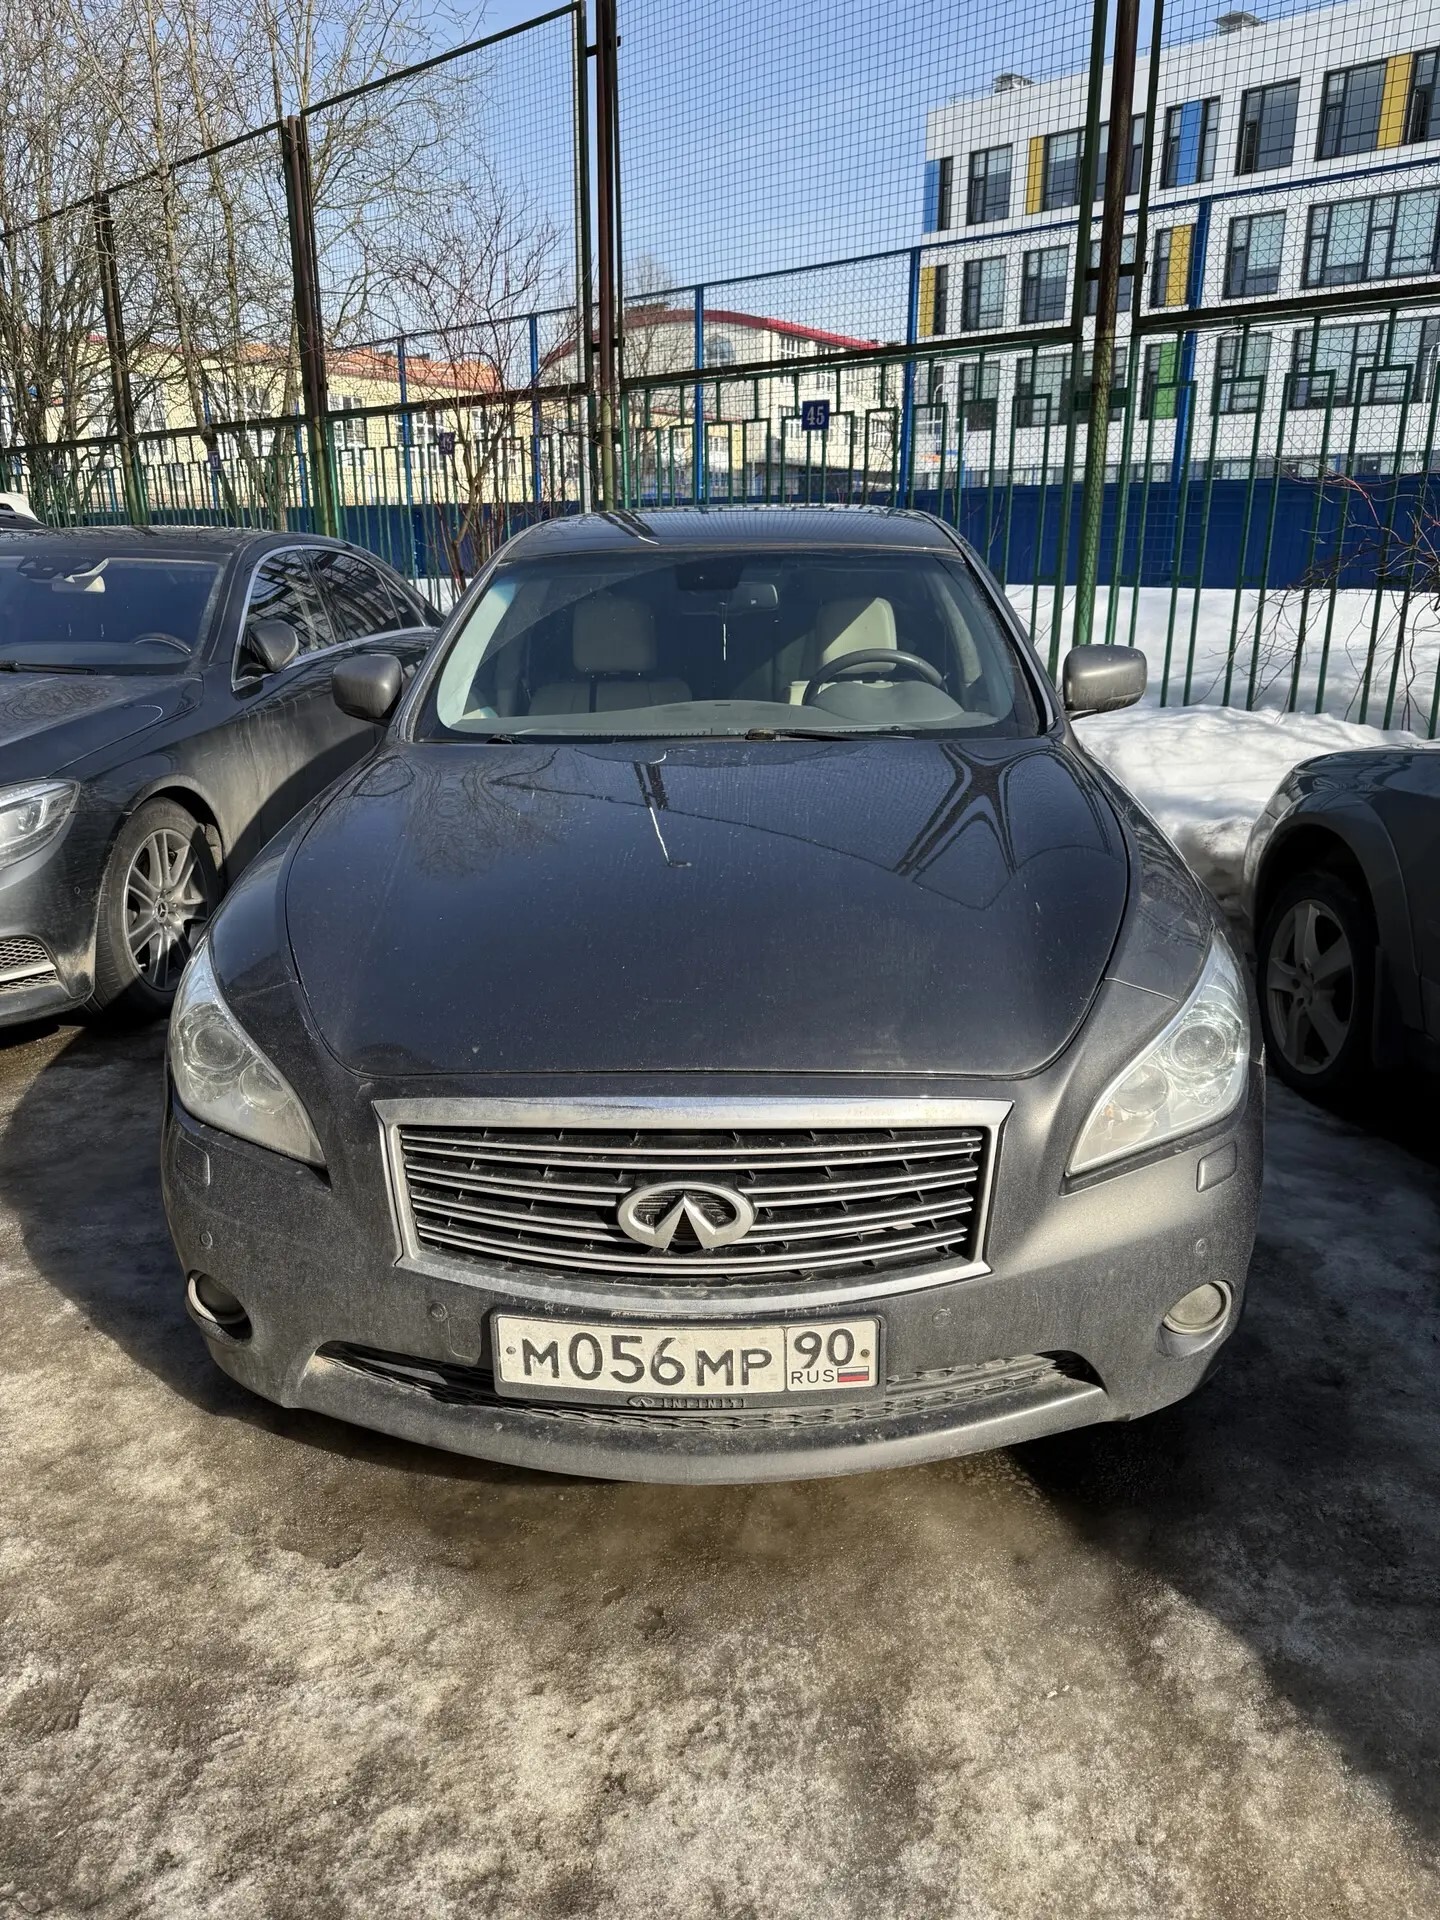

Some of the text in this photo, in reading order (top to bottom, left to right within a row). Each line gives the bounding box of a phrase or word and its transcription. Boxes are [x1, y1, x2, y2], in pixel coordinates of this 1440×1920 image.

[807, 405, 825, 425] 45
[794, 1328, 855, 1369] 90
[791, 1369, 835, 1384] RUS
[661, 1398, 747, 1409] INFINITI
